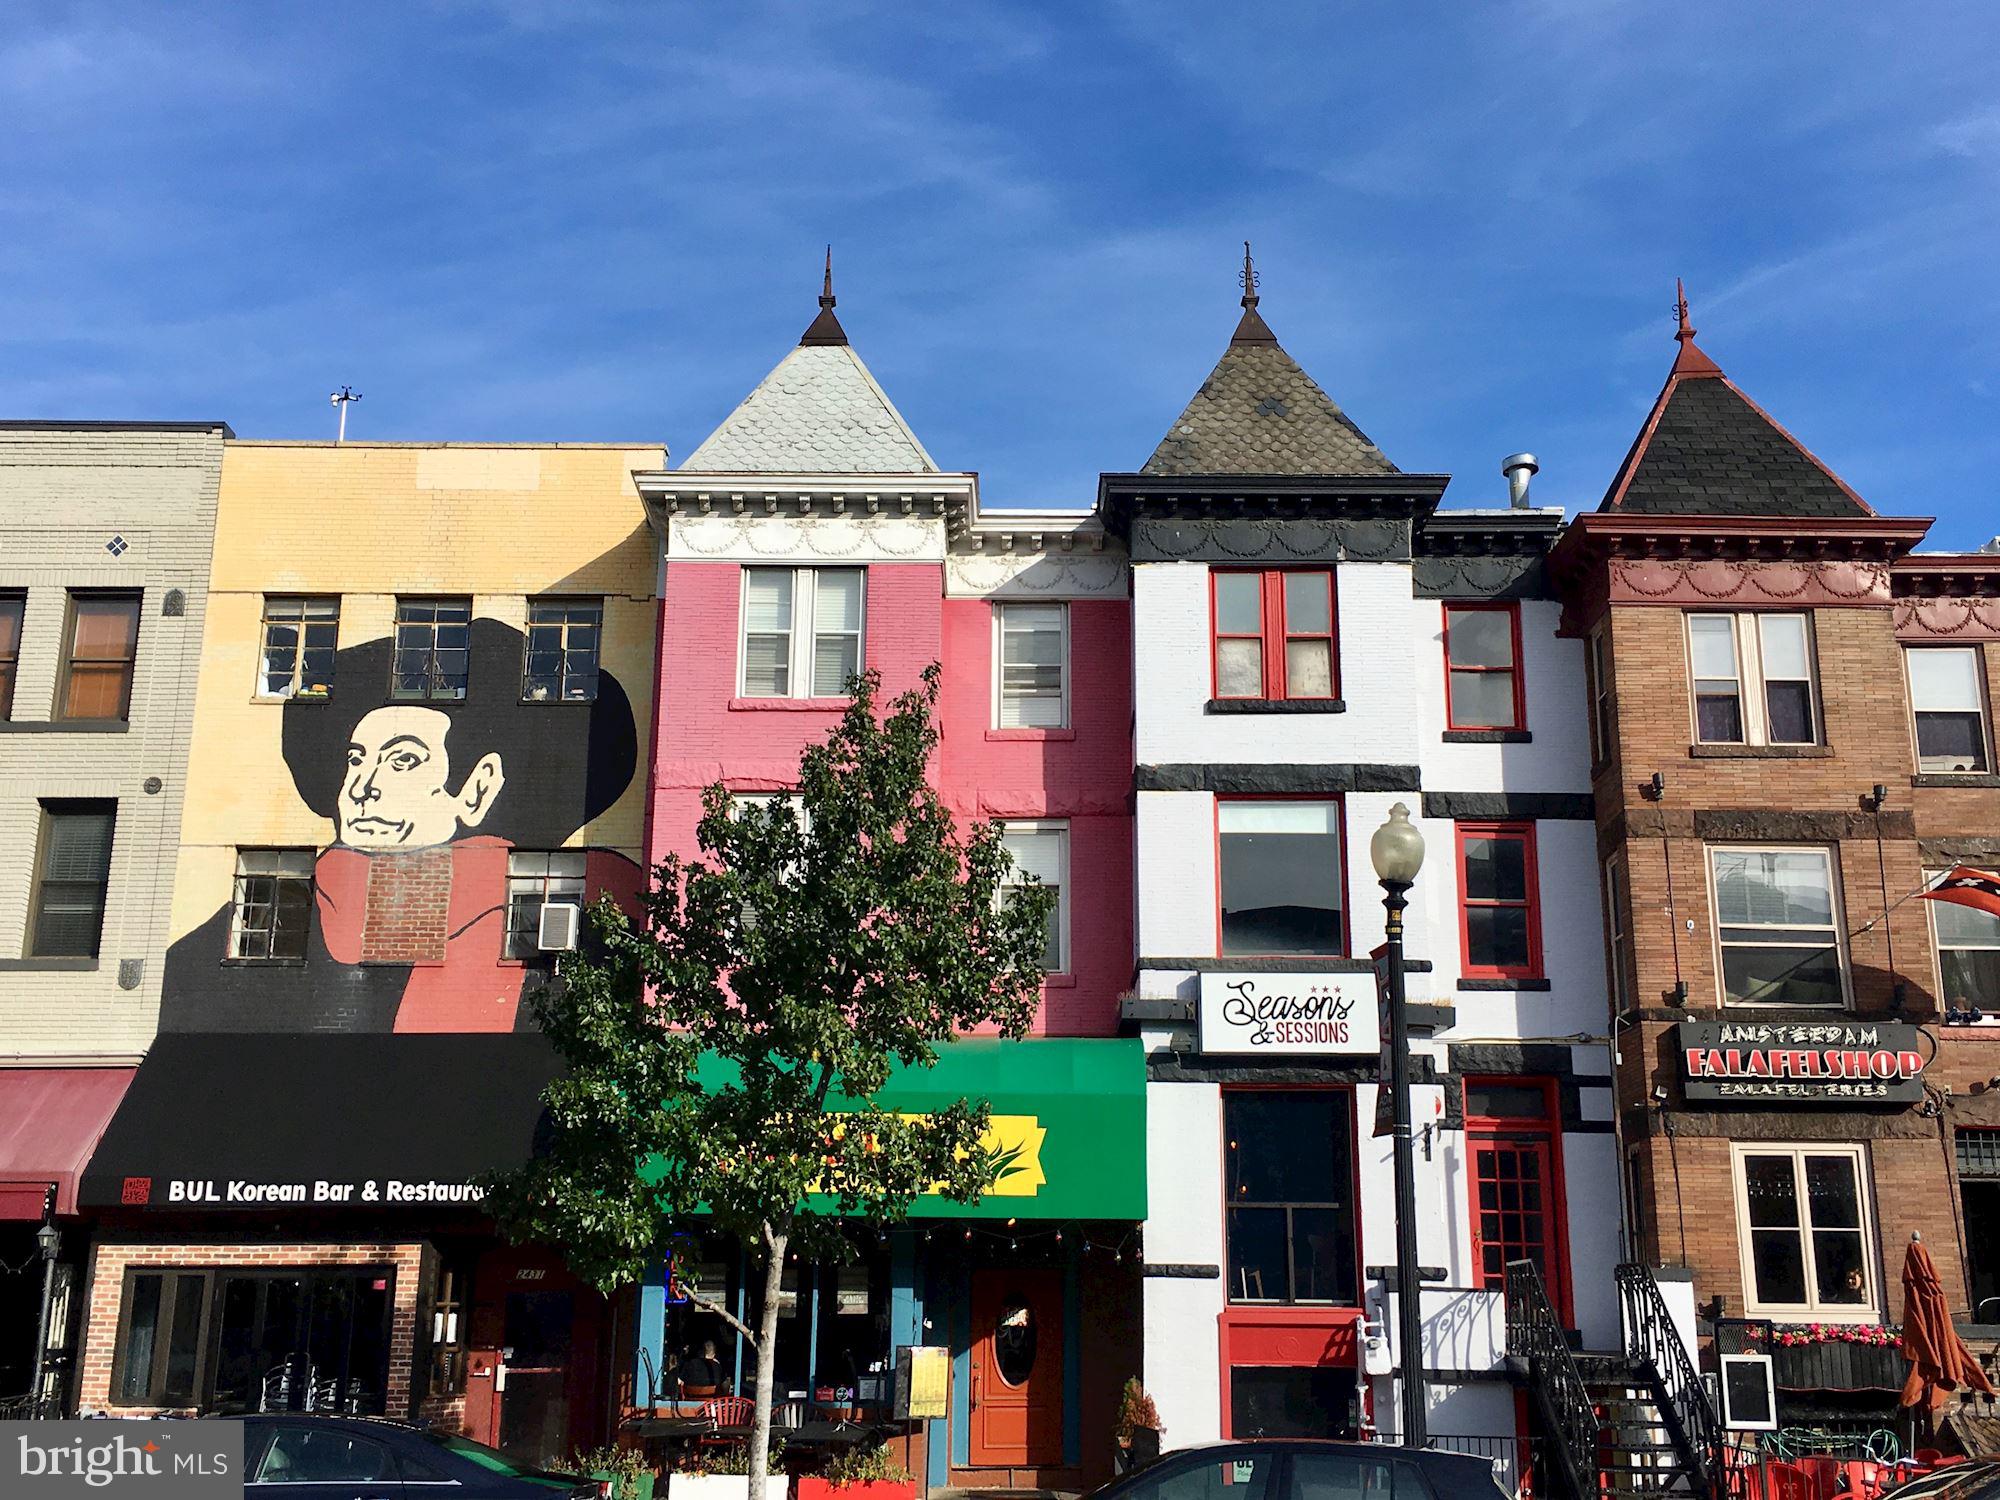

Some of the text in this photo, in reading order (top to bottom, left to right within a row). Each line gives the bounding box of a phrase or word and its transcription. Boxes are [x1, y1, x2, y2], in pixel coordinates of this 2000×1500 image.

[1223, 981, 1355, 1026] Seasons
[1250, 1021, 1349, 1045] & SESSIONS
[1719, 1024, 1879, 1046] AMSTERDAM
[169, 1181, 221, 1202] BUL
[226, 1181, 307, 1202] Korean
[313, 1181, 354, 1202] Bar
[361, 1180, 380, 1202] &
